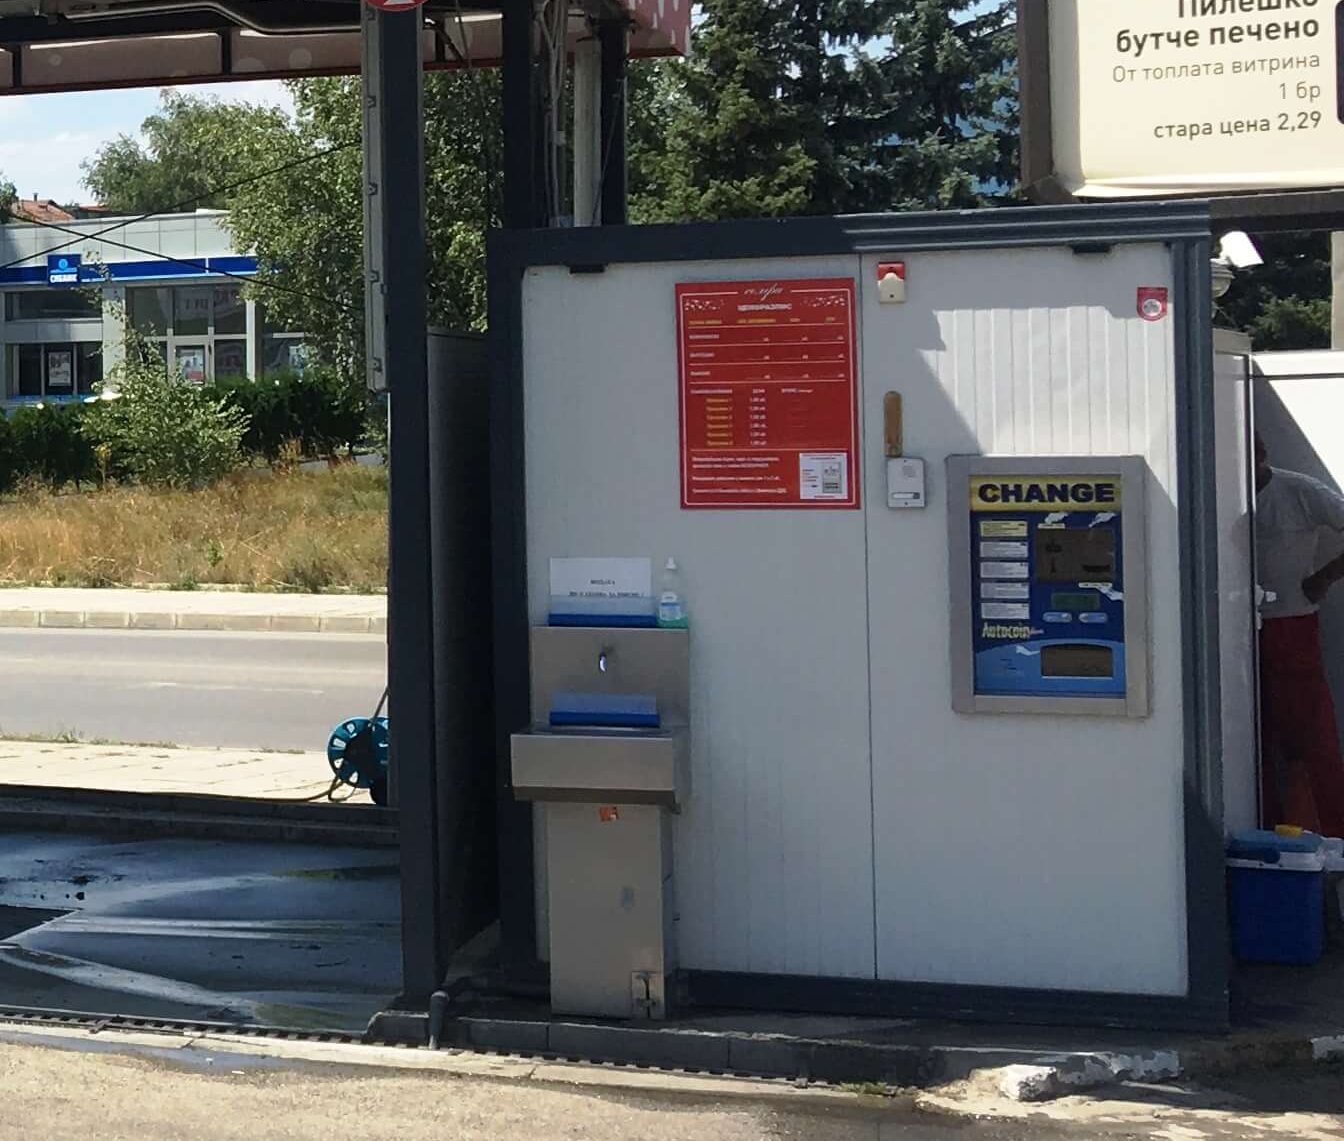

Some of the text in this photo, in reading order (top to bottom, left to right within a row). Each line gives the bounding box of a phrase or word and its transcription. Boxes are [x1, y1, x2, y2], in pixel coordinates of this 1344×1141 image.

[1116, 18, 1320, 57] бутче печено
[1112, 54, 1321, 83] От топлата витрина
[1279, 81, 1321, 102] 1 бр
[1153, 111, 1322, 140] стара цена 2,29
[977, 483, 1115, 503] CHANGE
